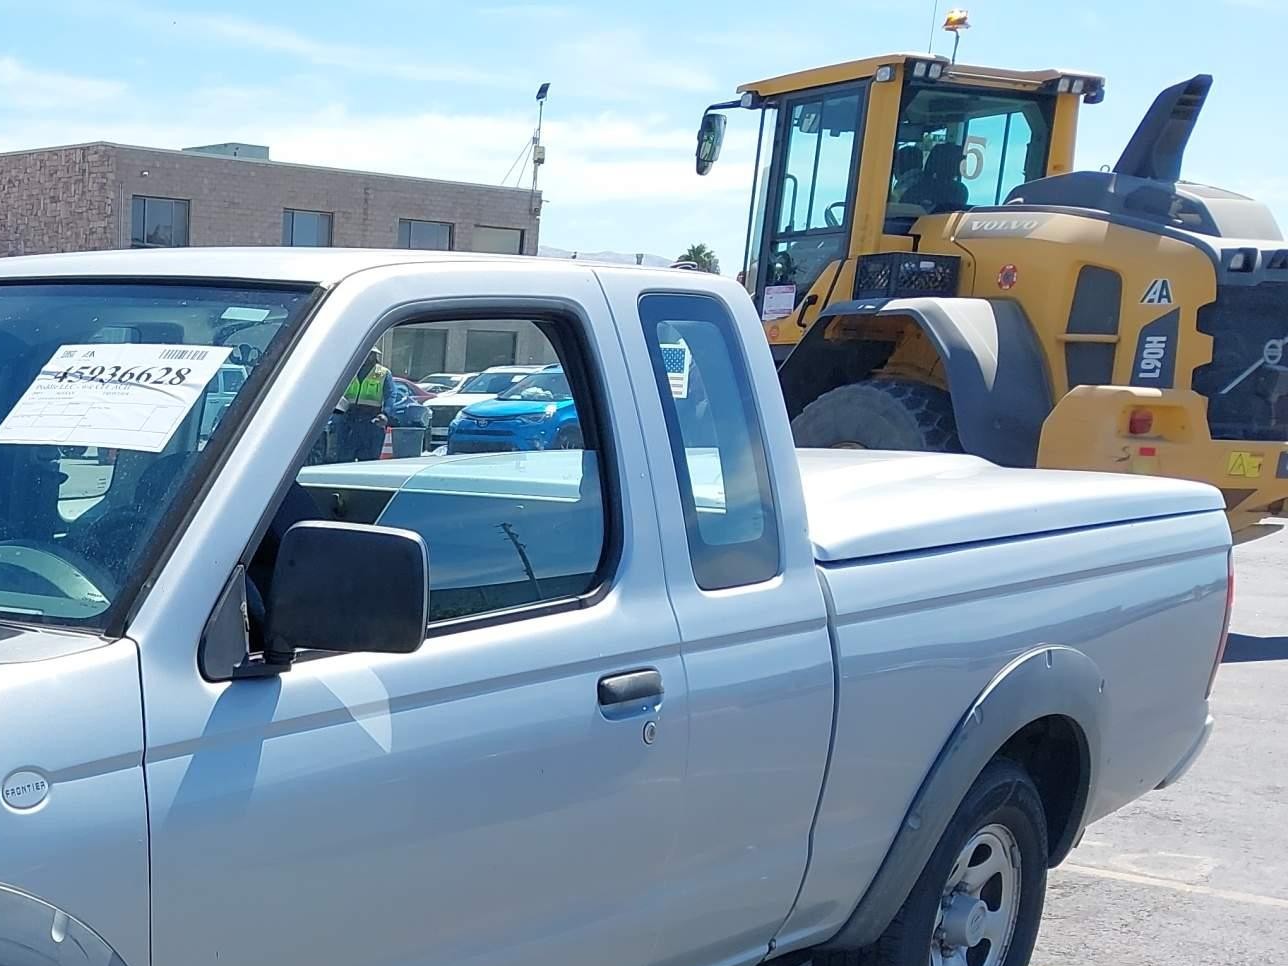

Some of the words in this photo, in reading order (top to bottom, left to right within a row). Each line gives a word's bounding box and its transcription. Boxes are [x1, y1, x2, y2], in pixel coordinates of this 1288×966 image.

[972, 220, 1040, 231] VOLVO
[1138, 336, 1167, 378] L90H
[53, 365, 192, 386] 45936628
[5, 780, 46, 798] FRONTIER
